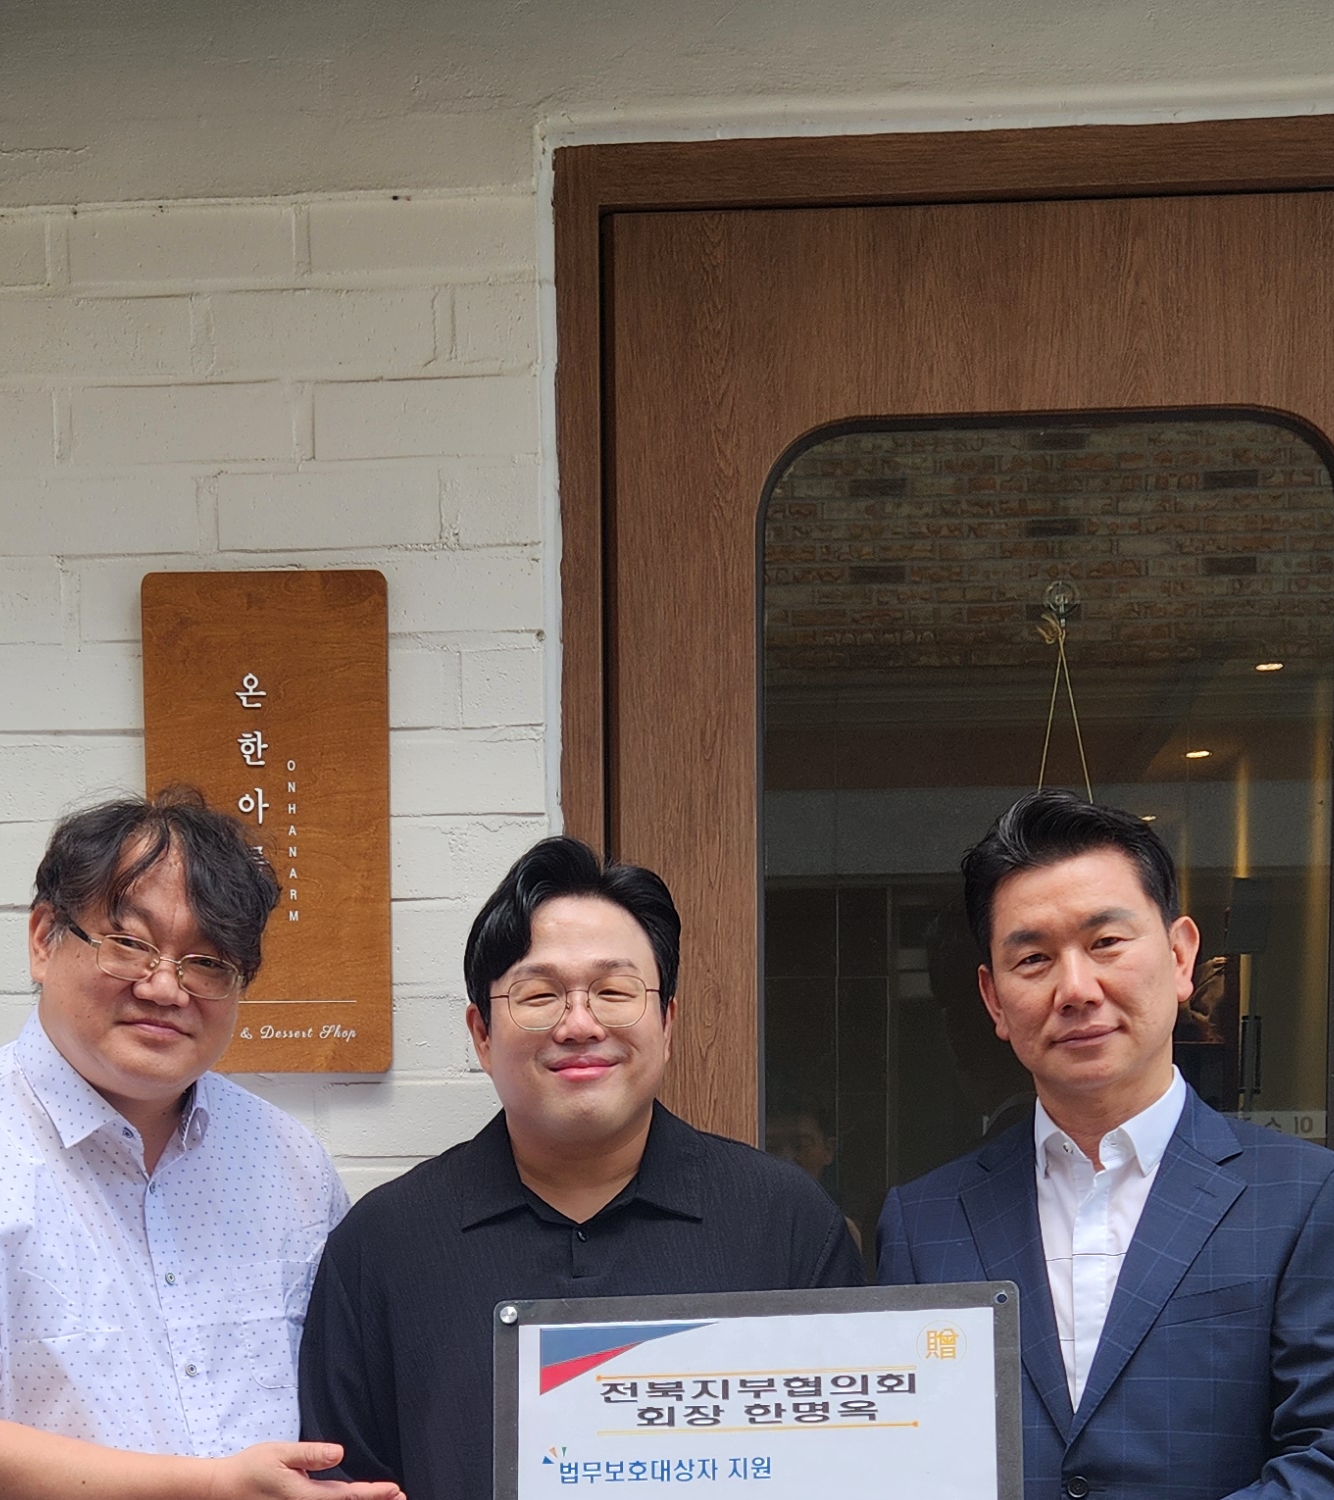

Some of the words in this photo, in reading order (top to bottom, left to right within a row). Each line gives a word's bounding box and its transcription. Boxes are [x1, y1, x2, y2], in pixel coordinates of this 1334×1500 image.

[286, 759, 299, 922] ONHANARM
[259, 1025, 313, 1039] Dessert
[319, 1024, 357, 1043] Shop
[600, 1373, 916, 1403] 전북지부협의회
[637, 1404, 725, 1427] 회장
[744, 1400, 878, 1424] 한명옥
[560, 1458, 718, 1484] 법무보호대상자
[729, 1457, 771, 1480] 지원
